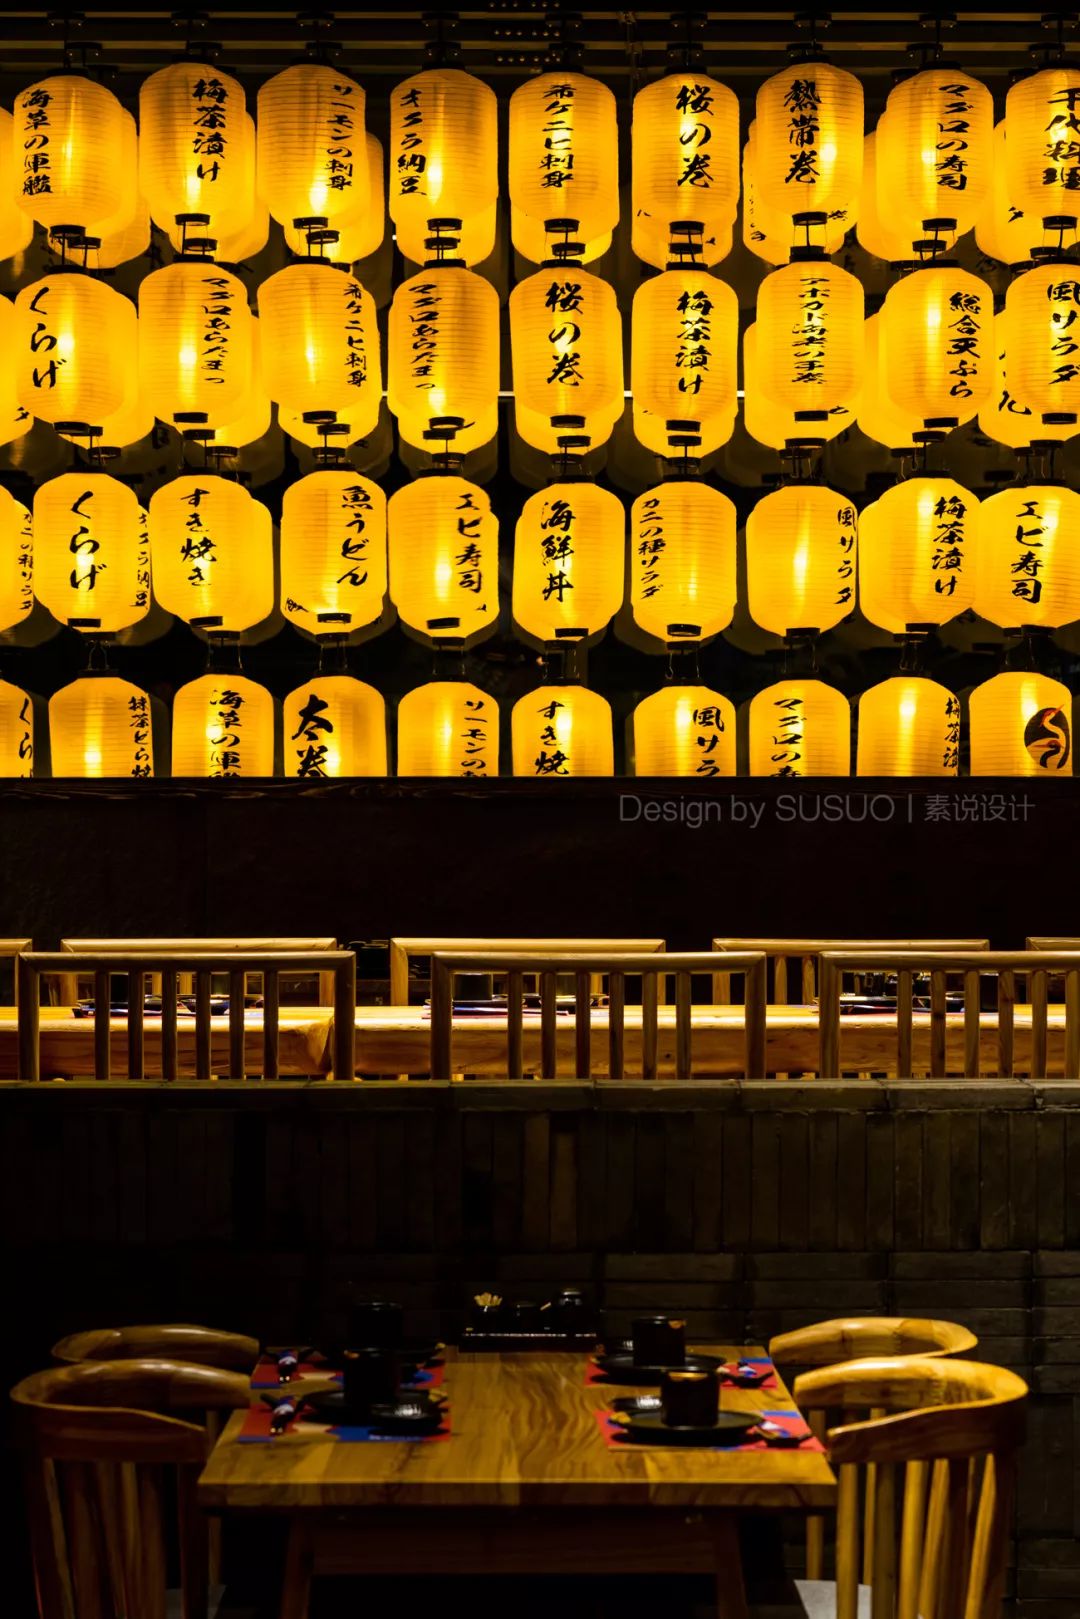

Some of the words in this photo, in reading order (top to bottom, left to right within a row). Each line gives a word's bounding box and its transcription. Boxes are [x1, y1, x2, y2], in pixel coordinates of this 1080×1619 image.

[192, 79, 229, 182] 梅茶漬け
[675, 84, 714, 188] 桜の巻
[30, 287, 66, 387] くらげ
[546, 282, 583, 385] 桜の巻
[676, 291, 713, 394] 梅茶漬け
[947, 292, 980, 397] 総合天ぷら
[70, 491, 106, 589] くらげ
[181, 489, 216, 585] すき焼き
[337, 486, 372, 586] 魚うどん
[541, 501, 575, 602] 海鮮丼
[932, 496, 966, 595] 梅茶漬け
[19, 698, 33, 777] くら
